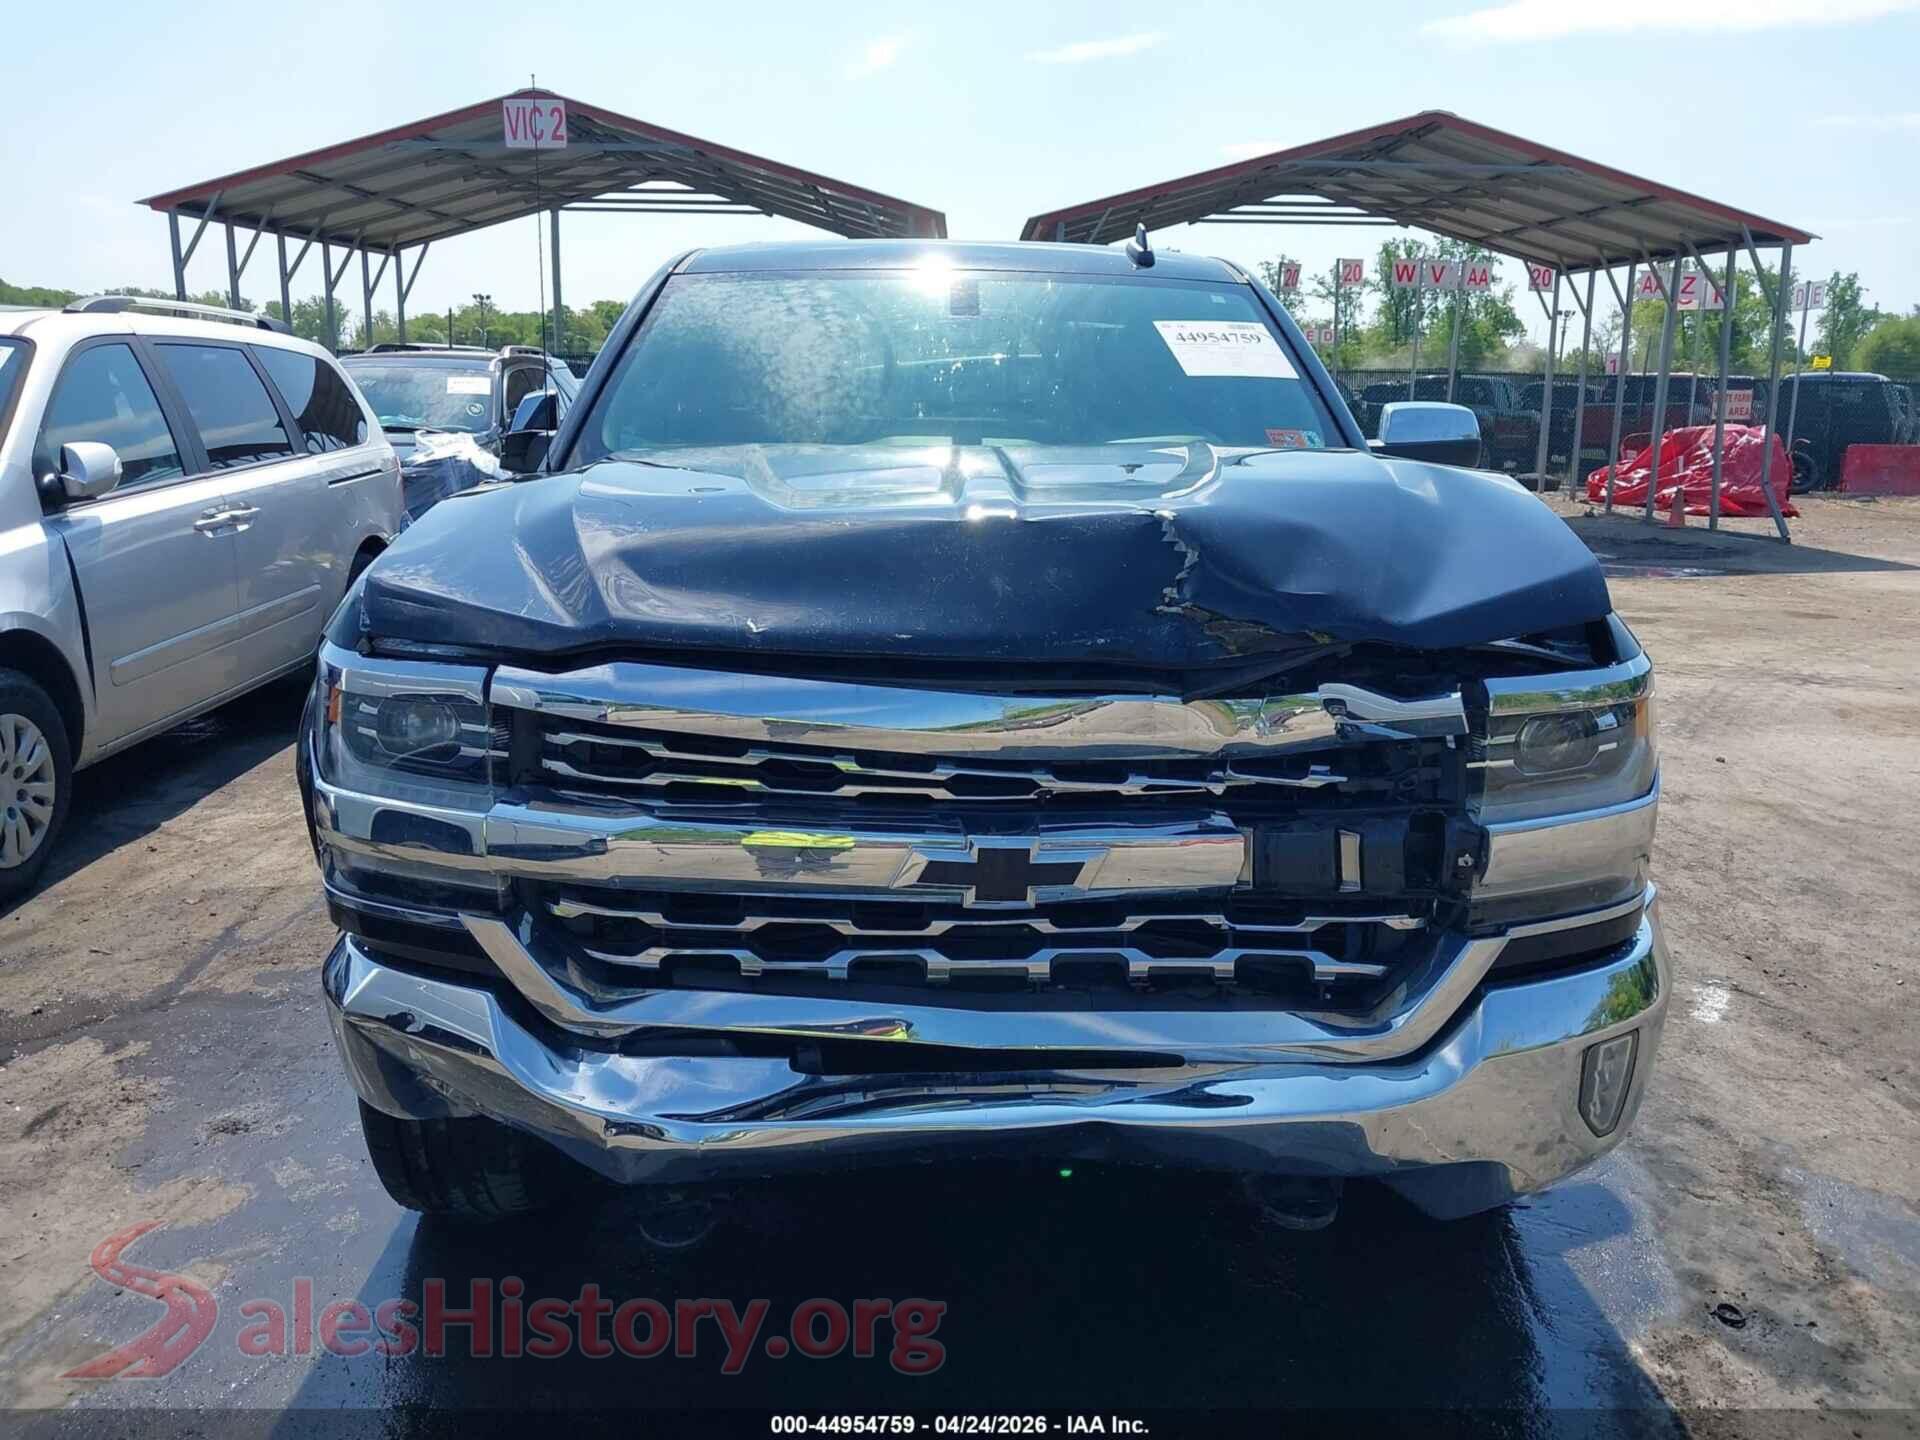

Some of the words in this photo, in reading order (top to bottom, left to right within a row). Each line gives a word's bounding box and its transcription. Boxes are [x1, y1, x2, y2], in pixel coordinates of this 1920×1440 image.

[505, 106, 544, 141] VIC
[550, 107, 564, 141] 2
[1343, 263, 1361, 282] 20
[1395, 264, 1416, 282] W
[1431, 265, 1445, 283] V
[1467, 268, 1488, 286] AA
[1531, 268, 1551, 287] 20
[1681, 276, 1696, 294] Z
[1175, 332, 1262, 344] 44954759
